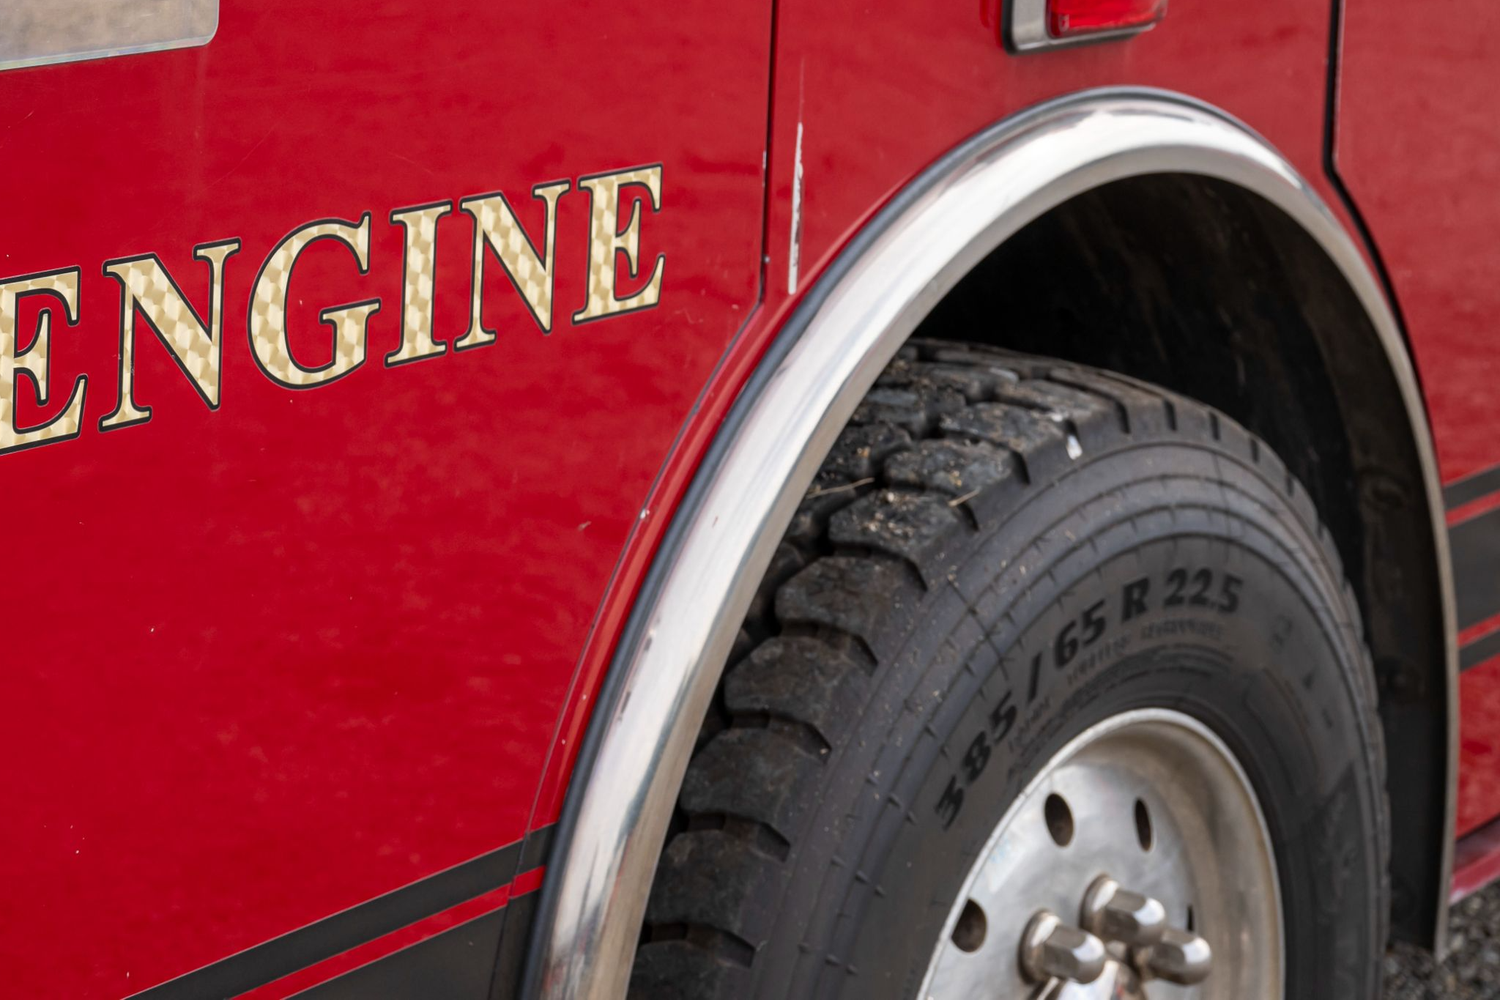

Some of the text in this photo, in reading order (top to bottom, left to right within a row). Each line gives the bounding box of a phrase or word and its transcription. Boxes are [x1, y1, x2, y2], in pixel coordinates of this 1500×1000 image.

[933, 691, 1017, 831] 385
[1054, 600, 1107, 668] 65
[1122, 576, 1150, 622] R
